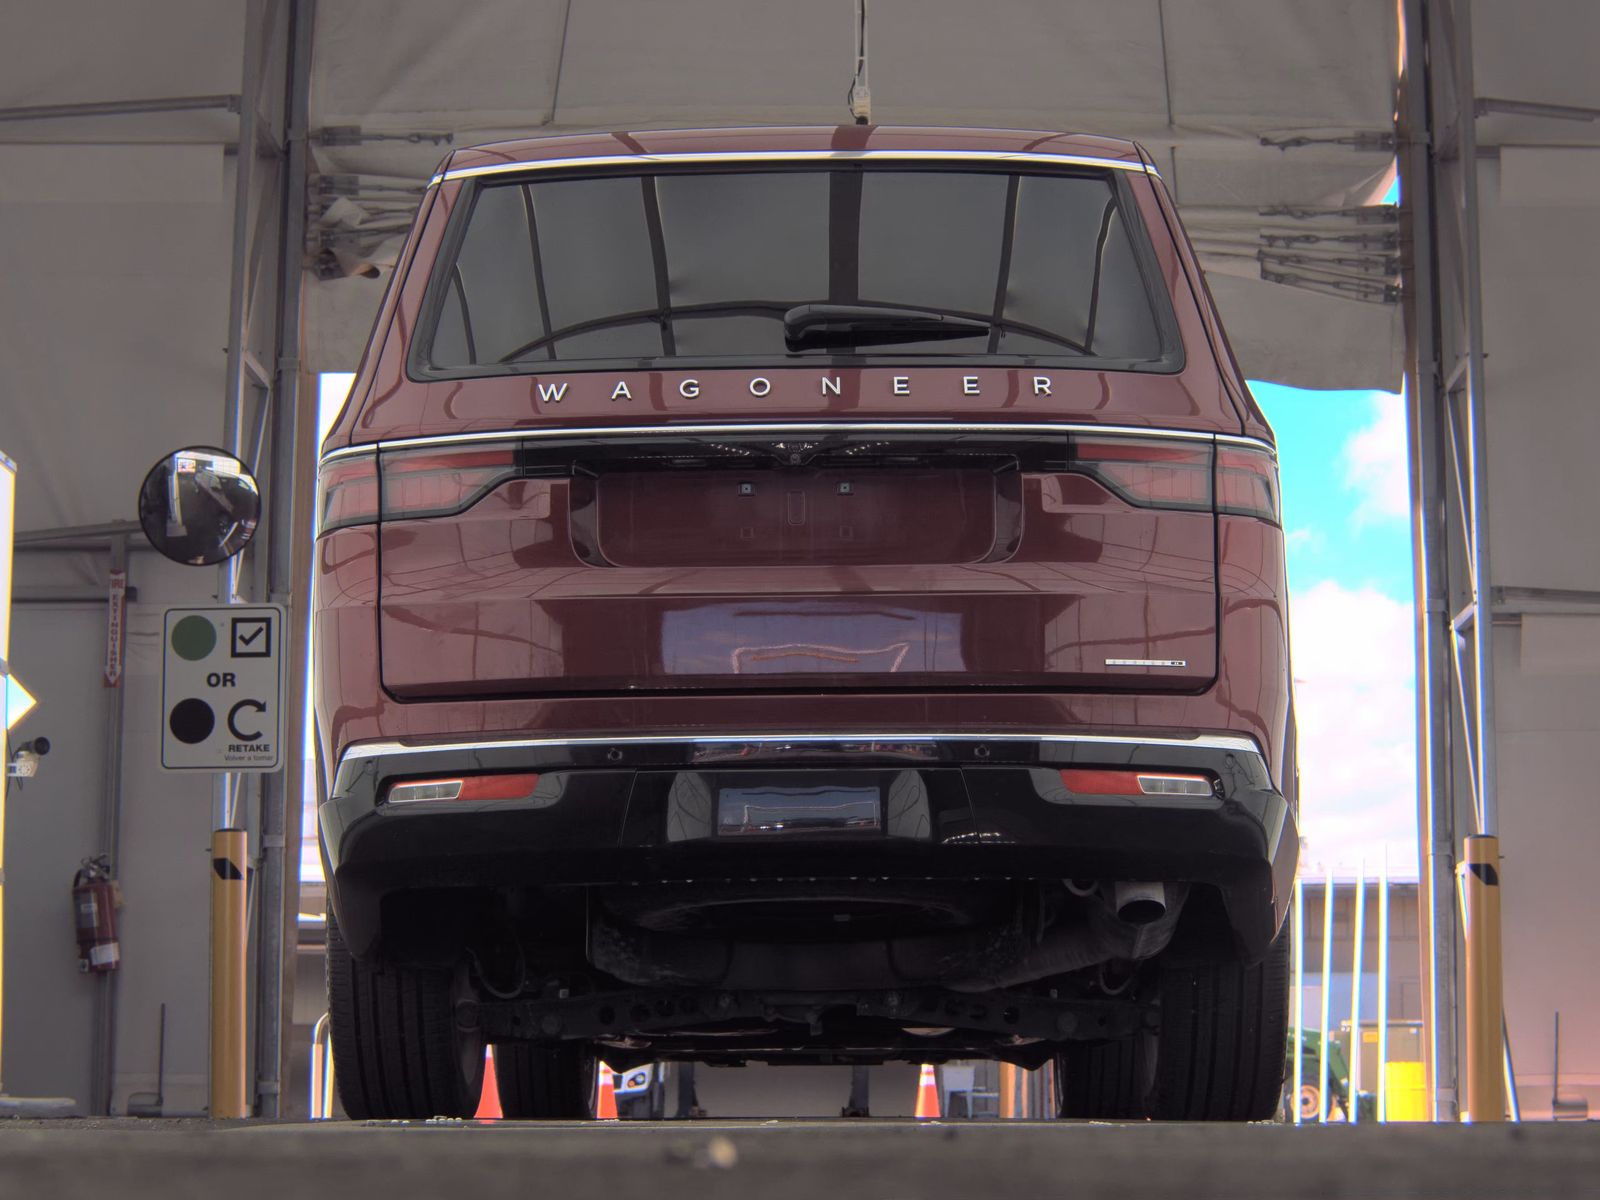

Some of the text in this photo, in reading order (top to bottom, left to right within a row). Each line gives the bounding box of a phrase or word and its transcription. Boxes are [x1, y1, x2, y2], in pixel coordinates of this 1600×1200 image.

[538, 374, 1053, 404] WAGONEER
[206, 672, 236, 687] OR
[228, 744, 270, 753] RETAKE
